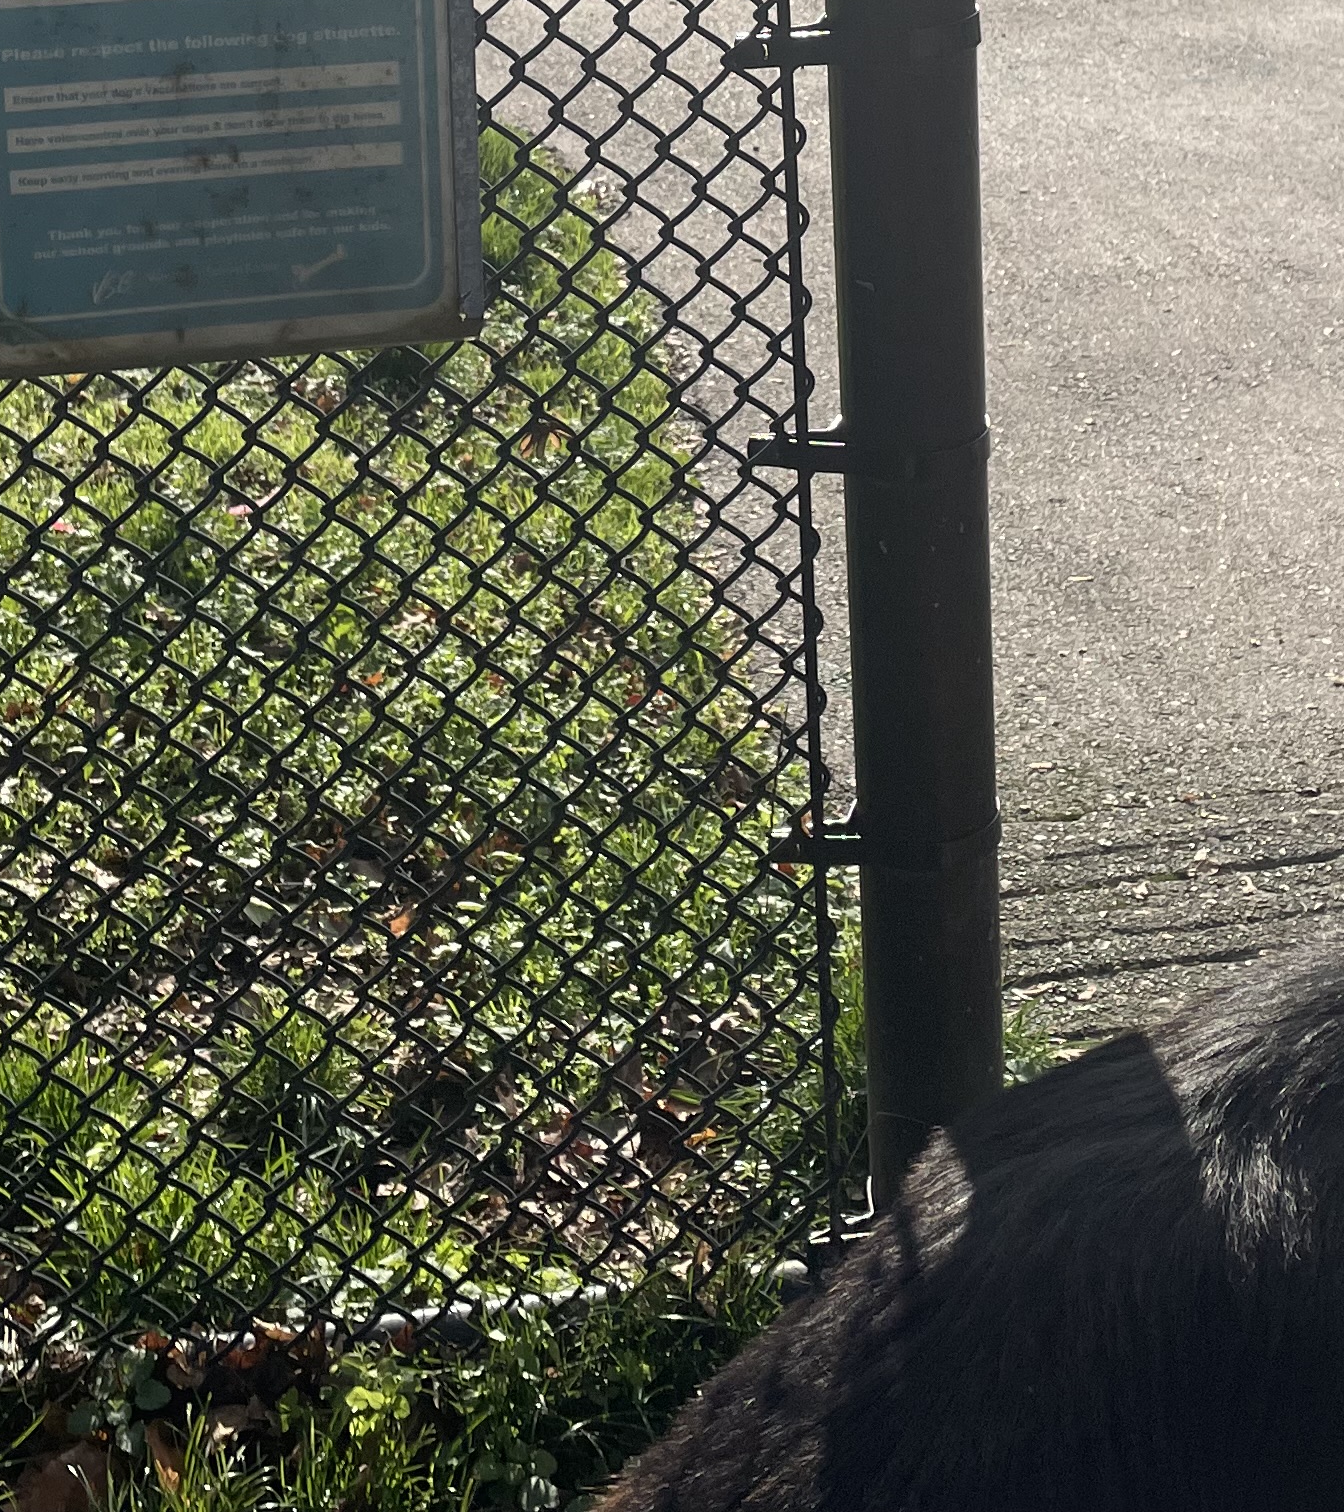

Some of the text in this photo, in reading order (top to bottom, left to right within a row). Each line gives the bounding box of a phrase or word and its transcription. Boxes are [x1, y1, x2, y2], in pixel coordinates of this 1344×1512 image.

[1, 47, 65, 63] Please
[71, 42, 143, 60] respect
[149, 37, 179, 52] the
[184, 32, 269, 50] following
[12, 93, 55, 107] Ensure
[57, 91, 79, 103] that
[81, 90, 108, 104] your
[219, 81, 237, 91] are
[15, 135, 44, 147] Have
[152, 125, 178, 138] your
[18, 175, 48, 189] Keep
[50, 173, 79, 186] early
[82, 170, 129, 184] morning
[132, 167, 154, 178] and
[33, 249, 58, 261] our
[61, 243, 109, 257] school
[112, 238, 171, 256] grounds
[275, 228, 306, 241] safe
[308, 226, 328, 237] for
[47, 227, 93, 241] Thank
[97, 227, 122, 239] you
